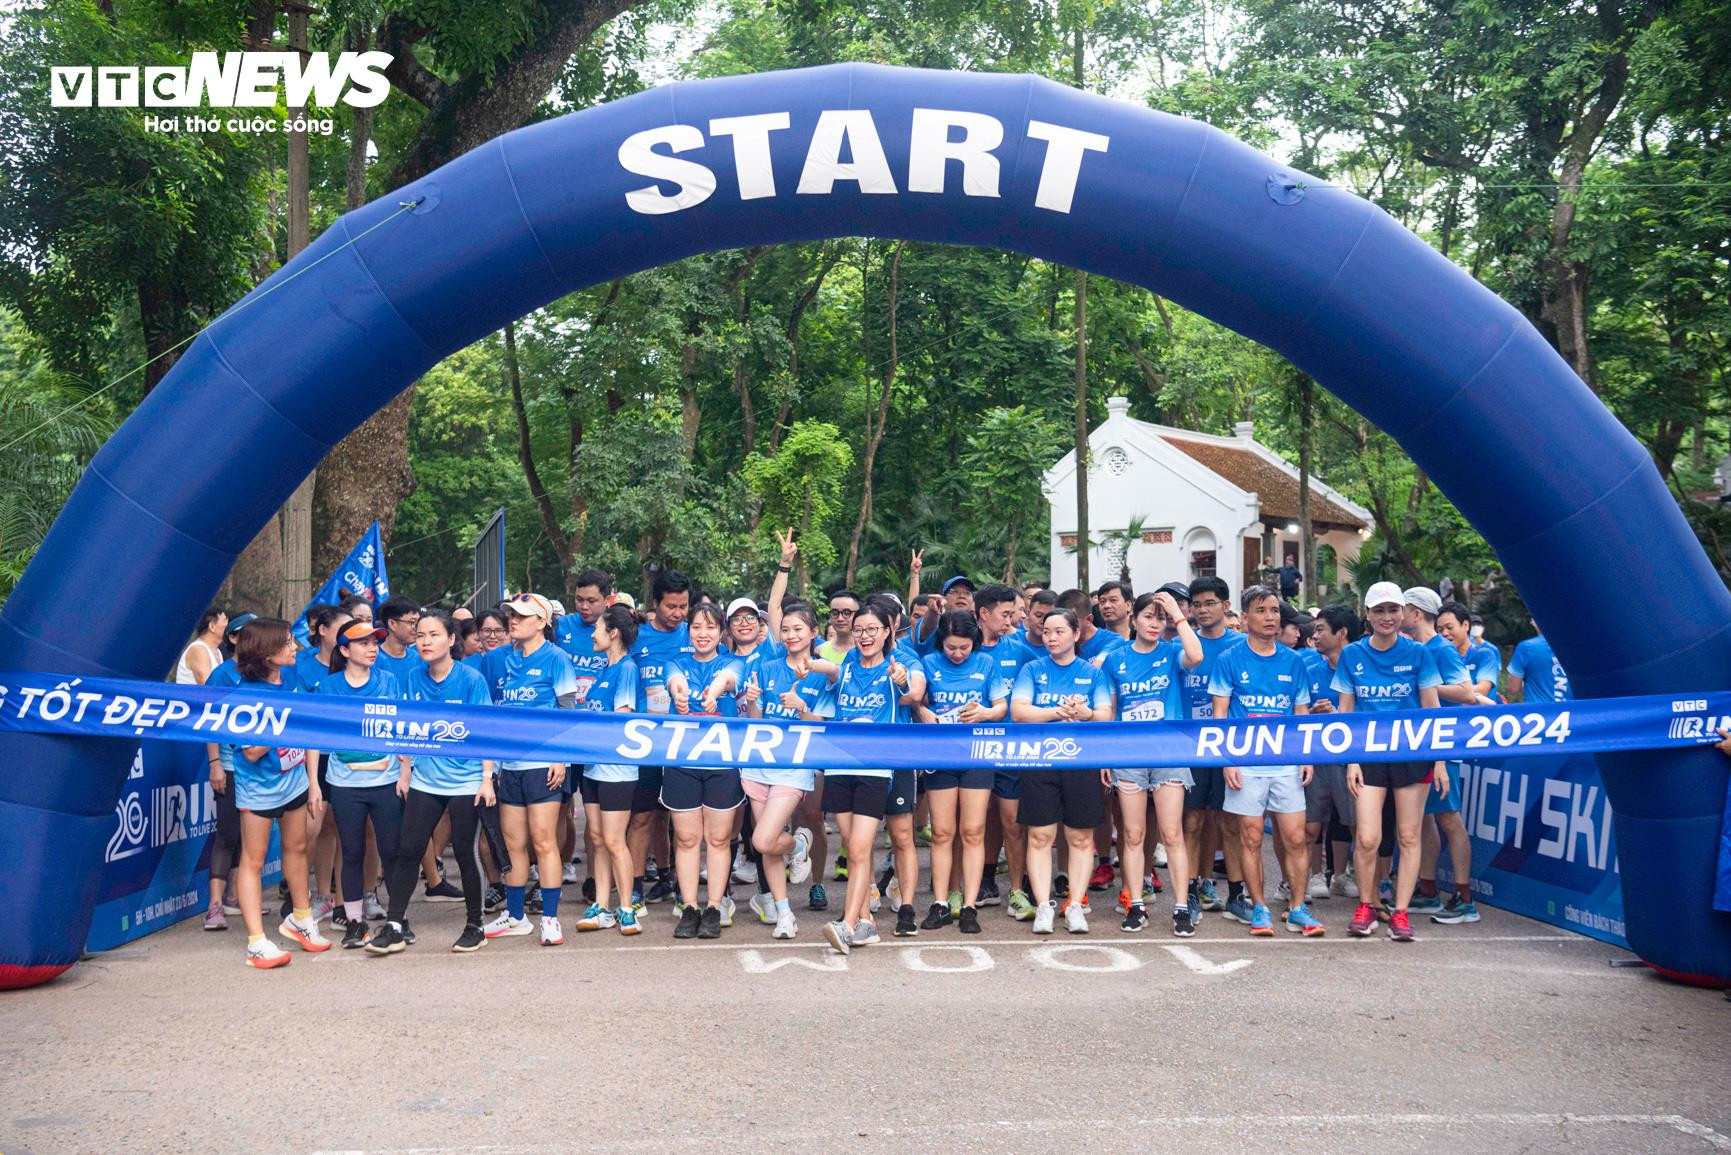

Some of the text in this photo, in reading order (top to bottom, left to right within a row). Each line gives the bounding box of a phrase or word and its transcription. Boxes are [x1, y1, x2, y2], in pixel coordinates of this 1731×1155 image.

[618, 107, 1110, 215] START
[17, 678, 102, 722] TỐT
[102, 695, 190, 735] ĐẸP
[193, 701, 292, 736] HƠN
[364, 703, 397, 716] VTC
[1131, 708, 1158, 721] 5172
[1672, 699, 1708, 713] VTC
[616, 718, 826, 764] START
[973, 727, 1005, 736] VTC
[1196, 711, 1571, 757] RUN TO LIVE 2024
[1537, 778, 1619, 874] SKI
